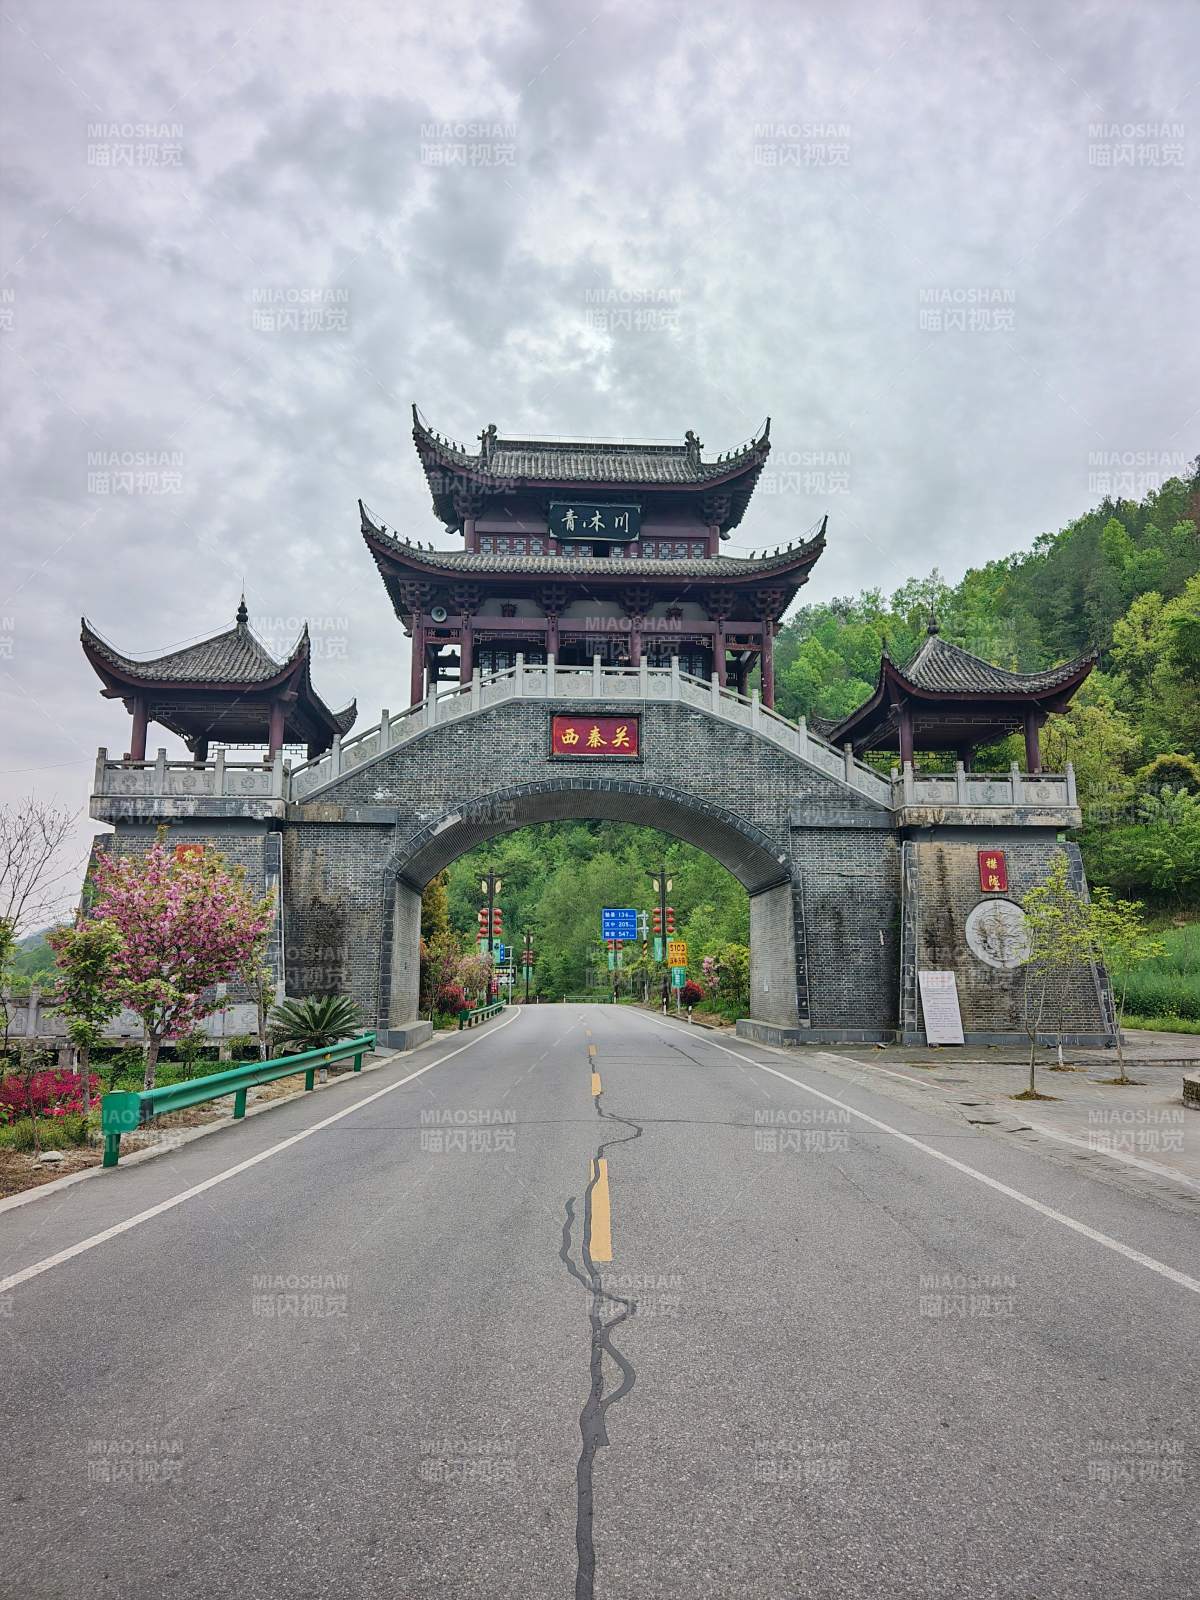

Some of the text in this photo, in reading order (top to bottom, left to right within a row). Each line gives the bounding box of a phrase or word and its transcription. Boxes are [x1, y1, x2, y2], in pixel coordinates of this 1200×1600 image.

[561, 508, 629, 533] 青木川
[561, 725, 630, 748] 西秦关
[670, 944, 686, 952] S103
